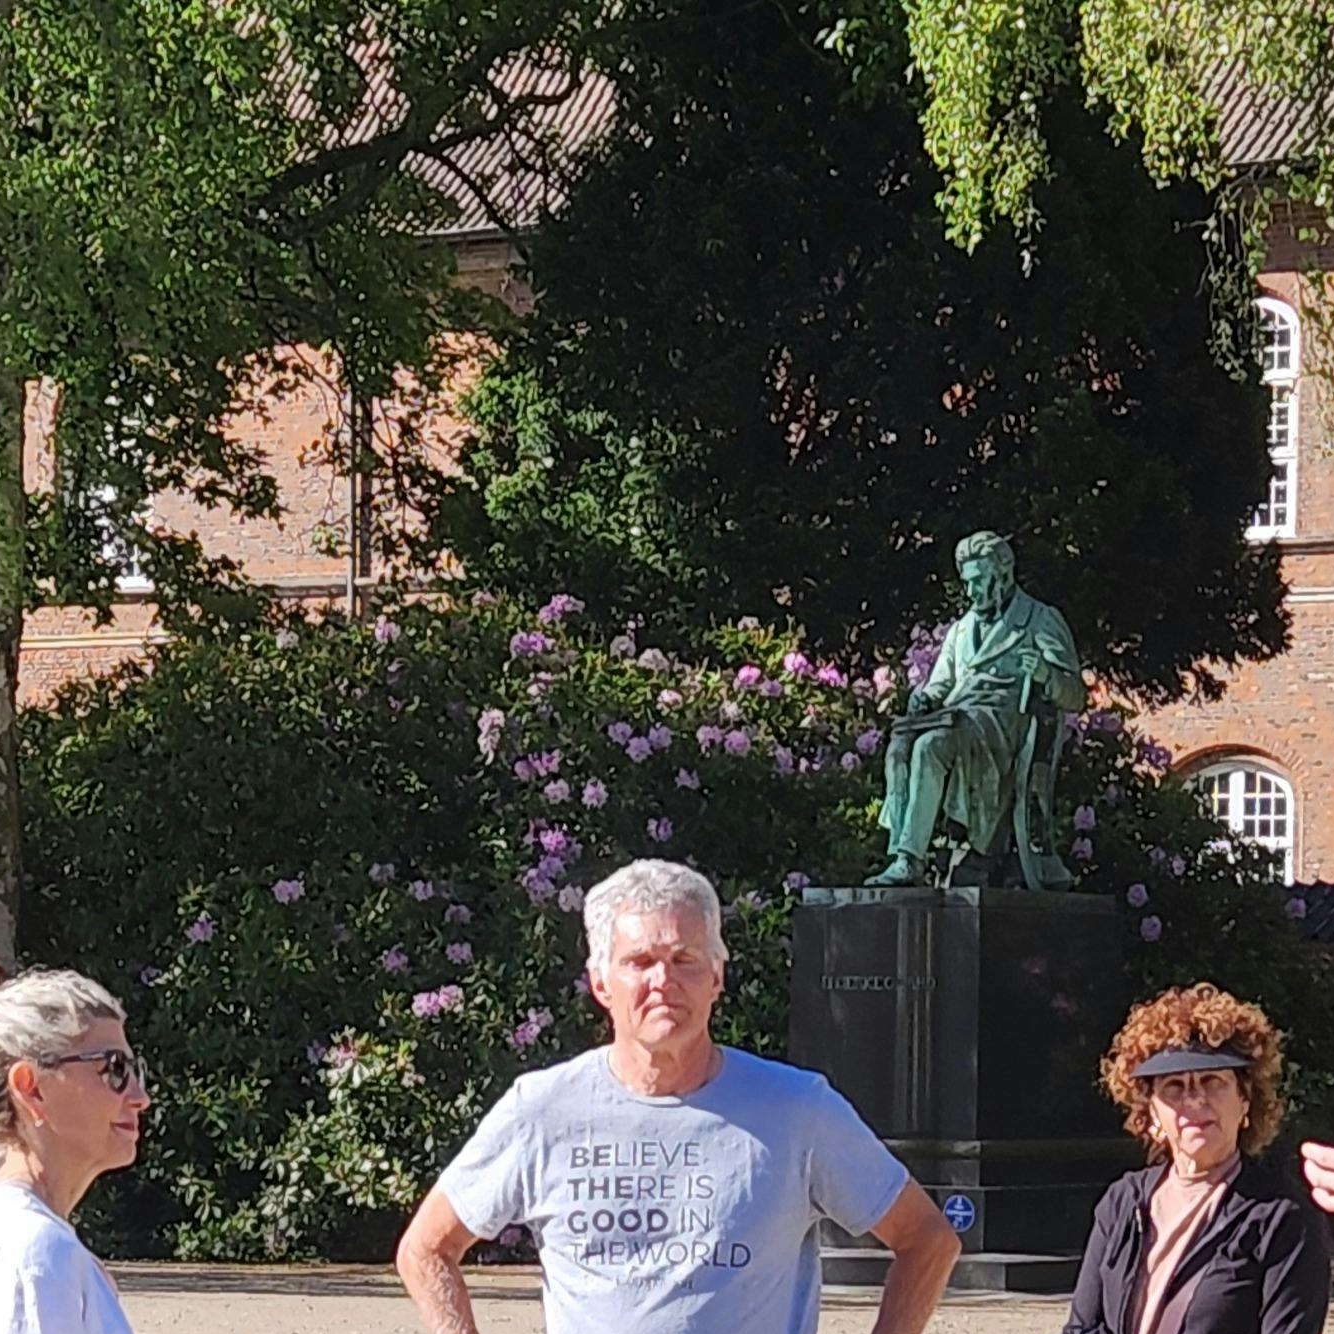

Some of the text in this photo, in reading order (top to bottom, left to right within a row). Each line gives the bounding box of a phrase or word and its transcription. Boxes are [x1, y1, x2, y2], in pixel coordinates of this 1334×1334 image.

[570, 1141, 700, 1168] BELIEVE
[567, 1174, 714, 1201] THERE IS
[567, 1205, 711, 1234] GOOD IN
[569, 1240, 752, 1268] THE WORLD
